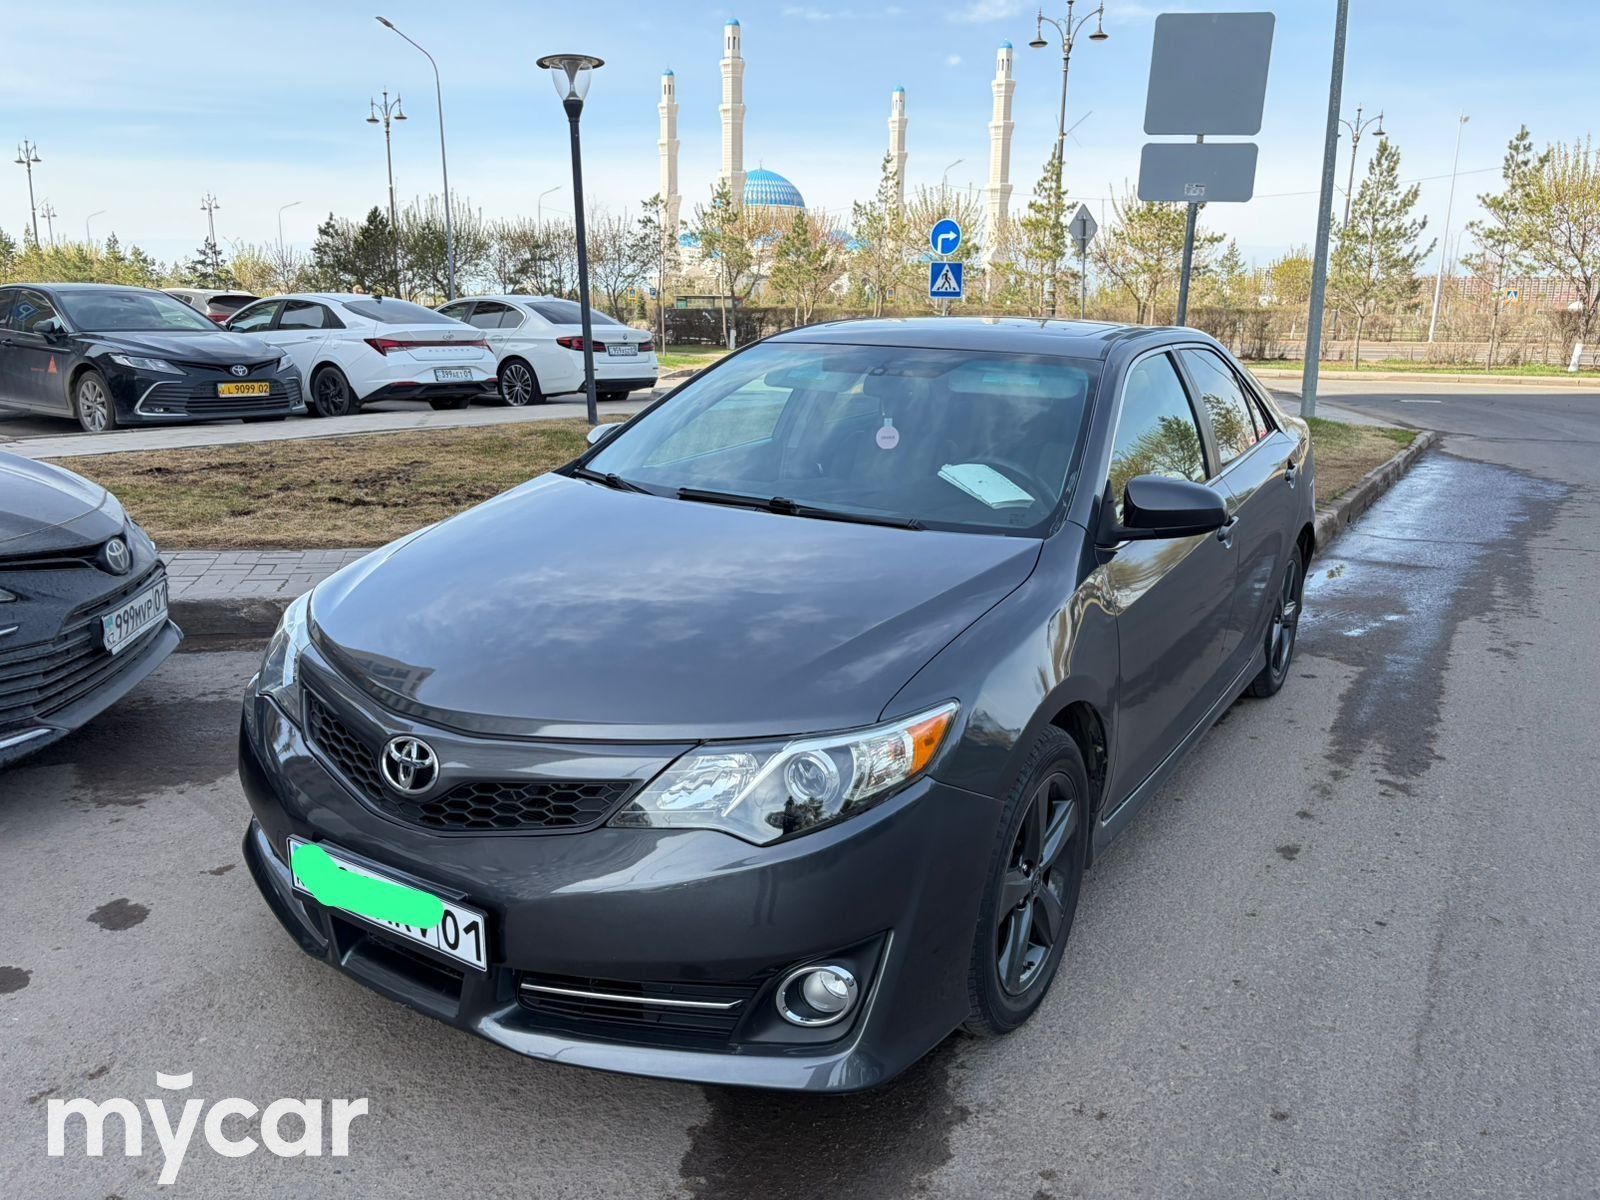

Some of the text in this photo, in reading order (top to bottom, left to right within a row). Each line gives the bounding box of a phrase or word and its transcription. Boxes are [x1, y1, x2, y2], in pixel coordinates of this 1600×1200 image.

[234, 384, 256, 394] 9099
[258, 384, 269, 394] 02
[154, 583, 167, 612] 01
[441, 910, 482, 962] 01
